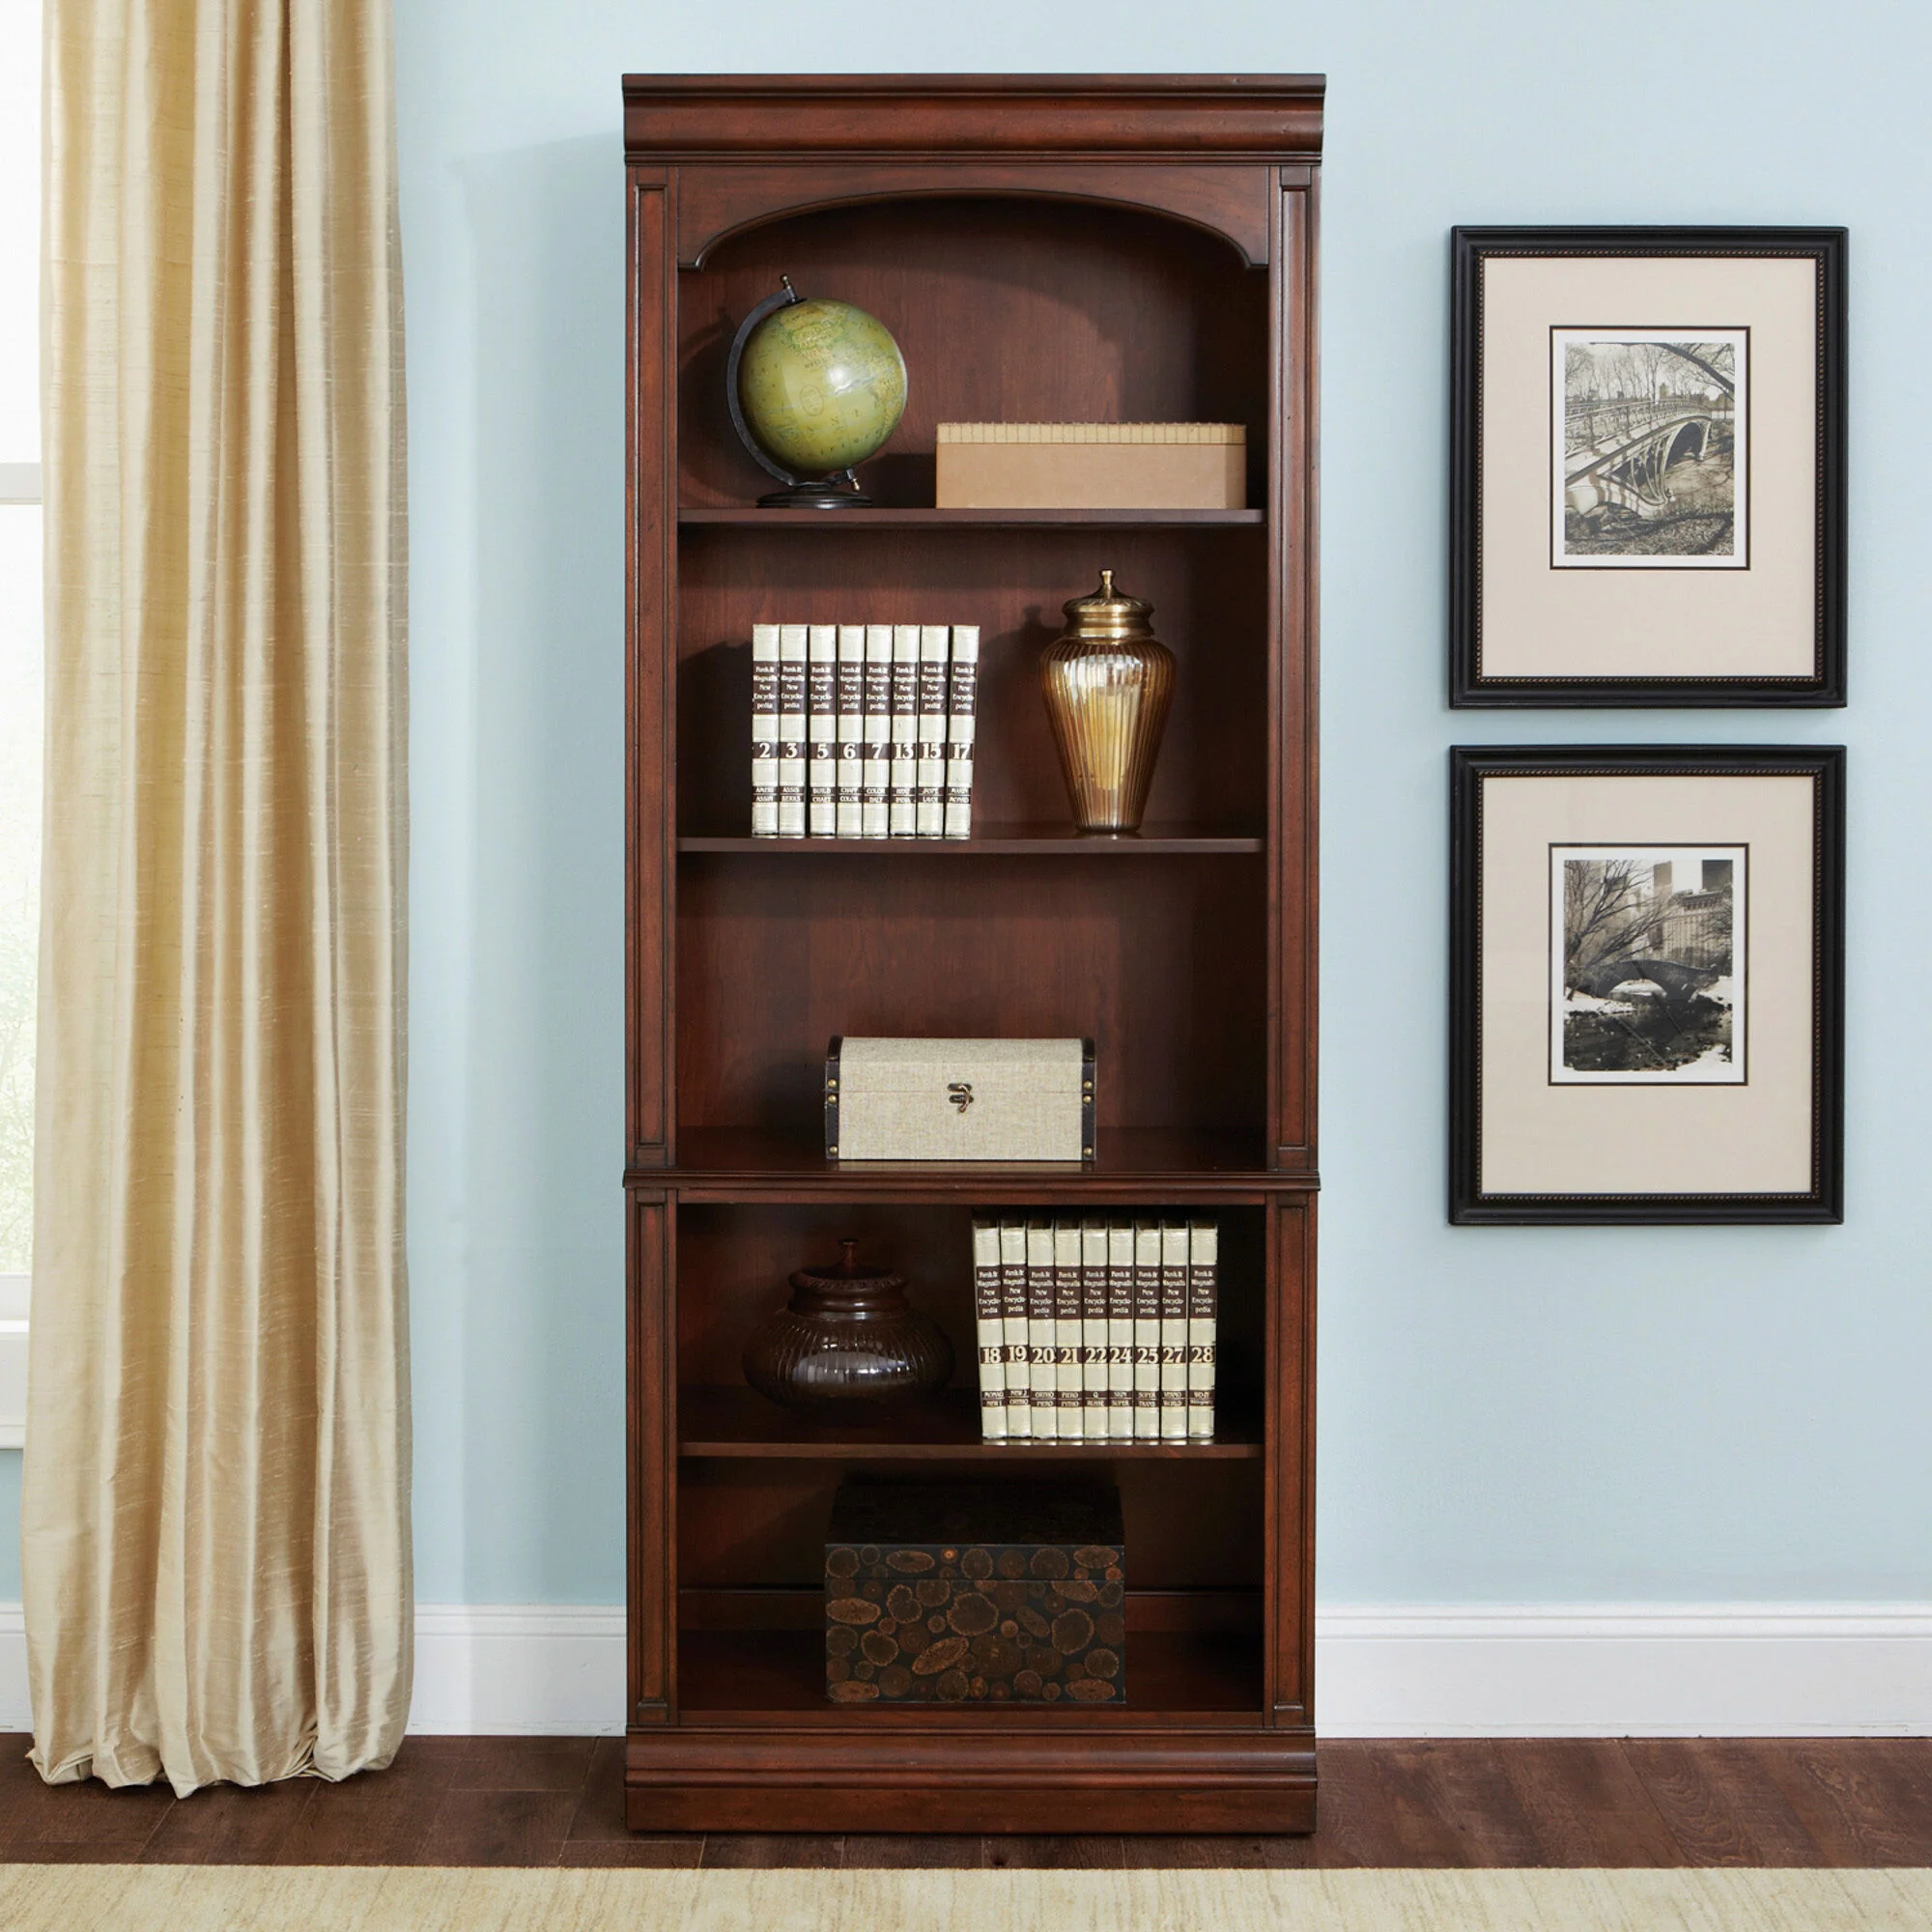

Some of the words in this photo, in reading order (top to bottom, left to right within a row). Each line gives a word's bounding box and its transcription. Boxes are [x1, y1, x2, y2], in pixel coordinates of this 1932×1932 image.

[759, 742, 771, 758] 2
[785, 742, 798, 758] 3
[816, 743, 829, 759] 5
[843, 743, 856, 759] 6
[871, 743, 883, 759] 7
[895, 743, 914, 759] 13
[923, 743, 942, 759] 15
[953, 743, 971, 759] 17
[1030, 1297, 1053, 1306] Encyclo-
[1057, 1297, 1079, 1306] Encyclo-
[1084, 1297, 1106, 1306] Encyclo-
[1110, 1297, 1132, 1306] Encyclo-
[1136, 1297, 1158, 1306] Encyclo-
[1162, 1297, 1184, 1306] Encyclo-
[983, 1349, 1001, 1363] 18
[1009, 1346, 1027, 1361] 19
[1032, 1348, 1055, 1364] 20
[1061, 1348, 1078, 1364] 21
[1085, 1348, 1107, 1364] 22
[1109, 1348, 1132, 1364] 24
[1137, 1348, 1159, 1364] 25
[1163, 1348, 1183, 1364] 27
[1192, 1348, 1213, 1362] 28
